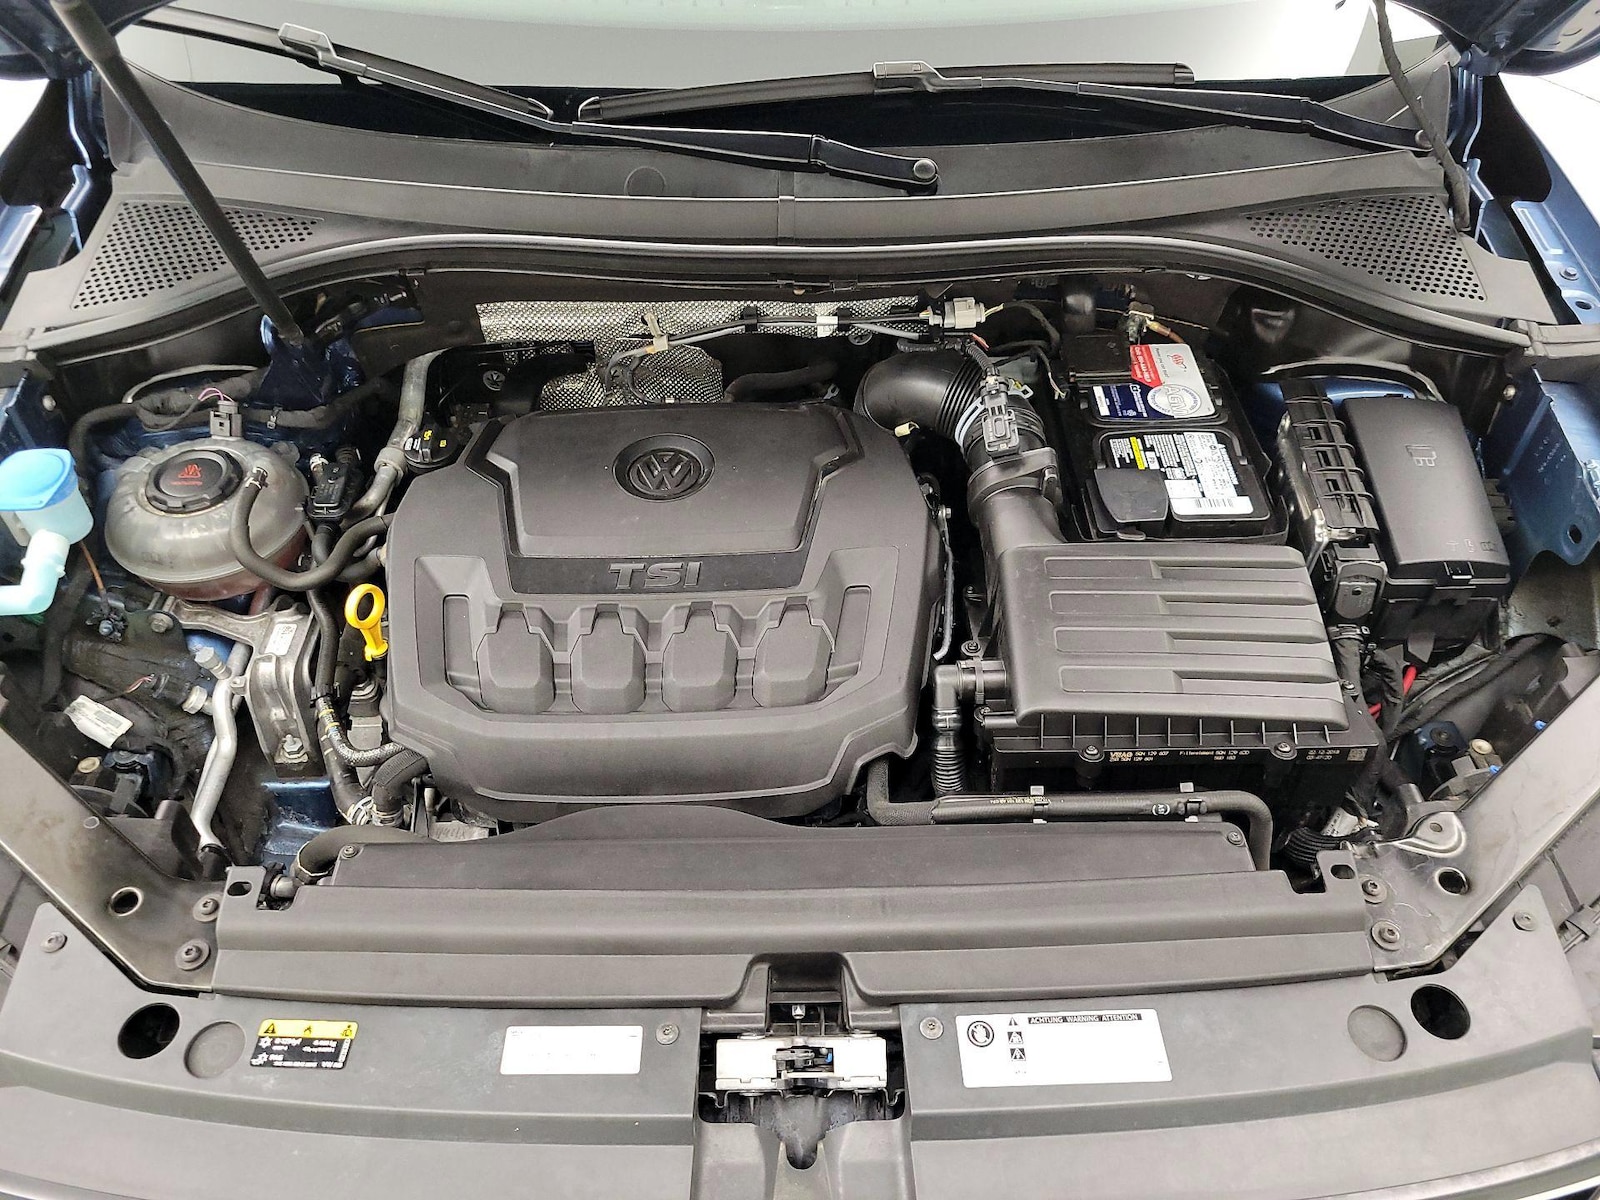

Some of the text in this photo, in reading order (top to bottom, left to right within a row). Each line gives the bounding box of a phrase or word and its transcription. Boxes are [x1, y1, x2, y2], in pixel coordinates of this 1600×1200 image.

[1165, 386, 1189, 415] AGM
[608, 561, 703, 590] TSI
[1030, 1013, 1138, 1024] ACHTUNG WARNING ATTENTION
